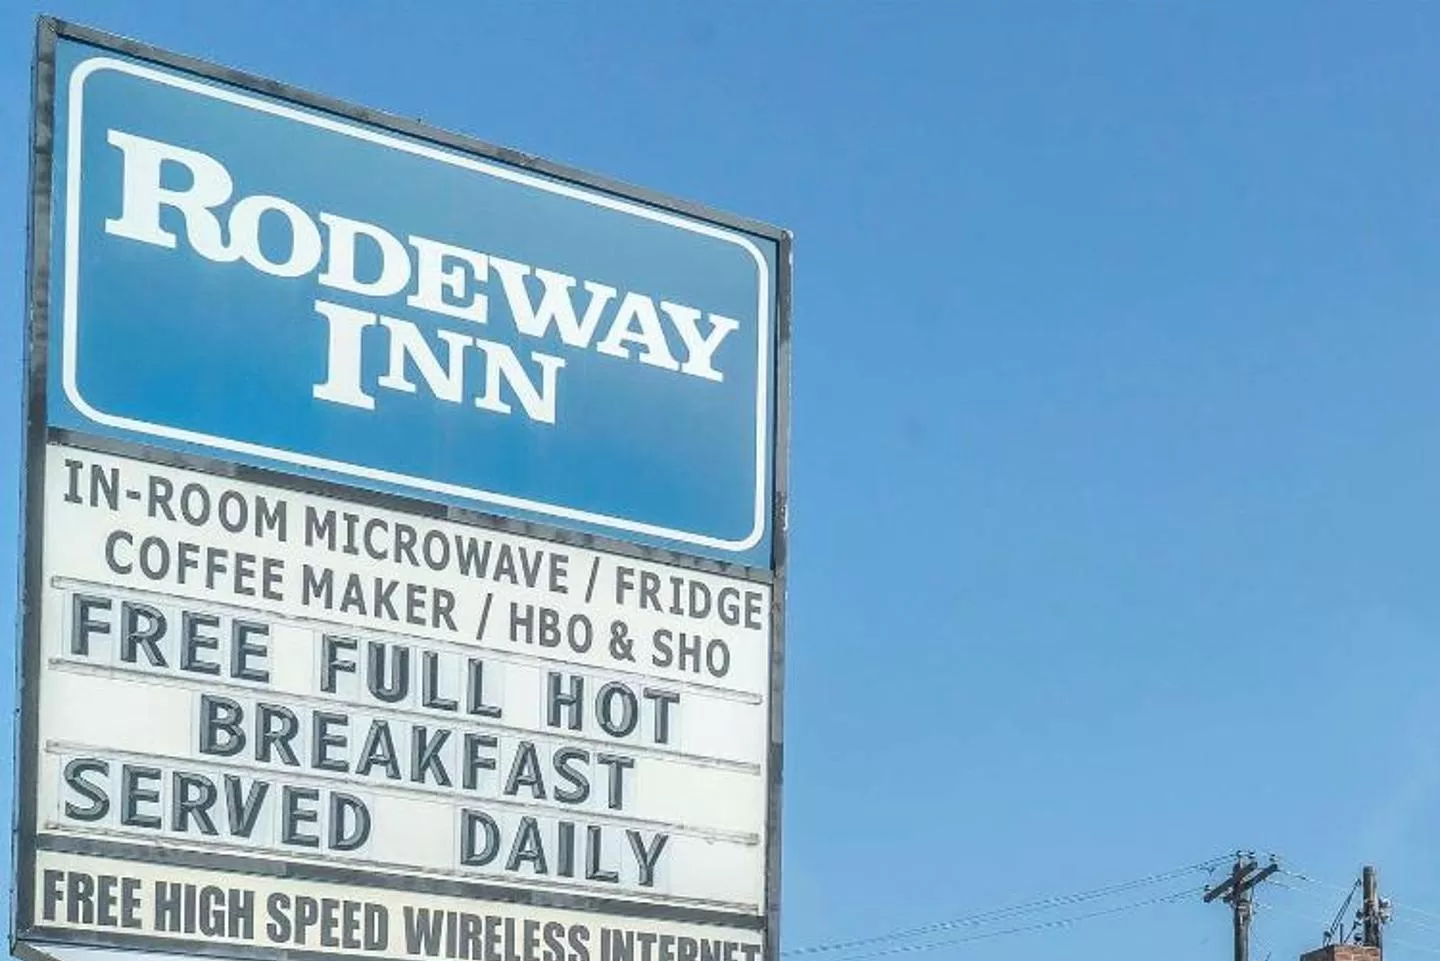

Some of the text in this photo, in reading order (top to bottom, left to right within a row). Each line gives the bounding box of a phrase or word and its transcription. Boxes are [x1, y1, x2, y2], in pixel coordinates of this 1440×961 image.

[105, 128, 739, 382] RODEWAY
[313, 301, 565, 424] INN
[64, 459, 763, 630] IN-ROOM MICROWAVE / FRIDGE
[105, 530, 730, 678] COFFEE MAKER / HBO & SHO
[70, 593, 680, 744] FREE FULL HOT
[64, 757, 669, 887] SERVED DAILY
[200, 694, 634, 811] BREAKFAST
[43, 869, 142, 928] FREE
[154, 881, 255, 940] HIGH
[266, 892, 388, 951] SPEED
